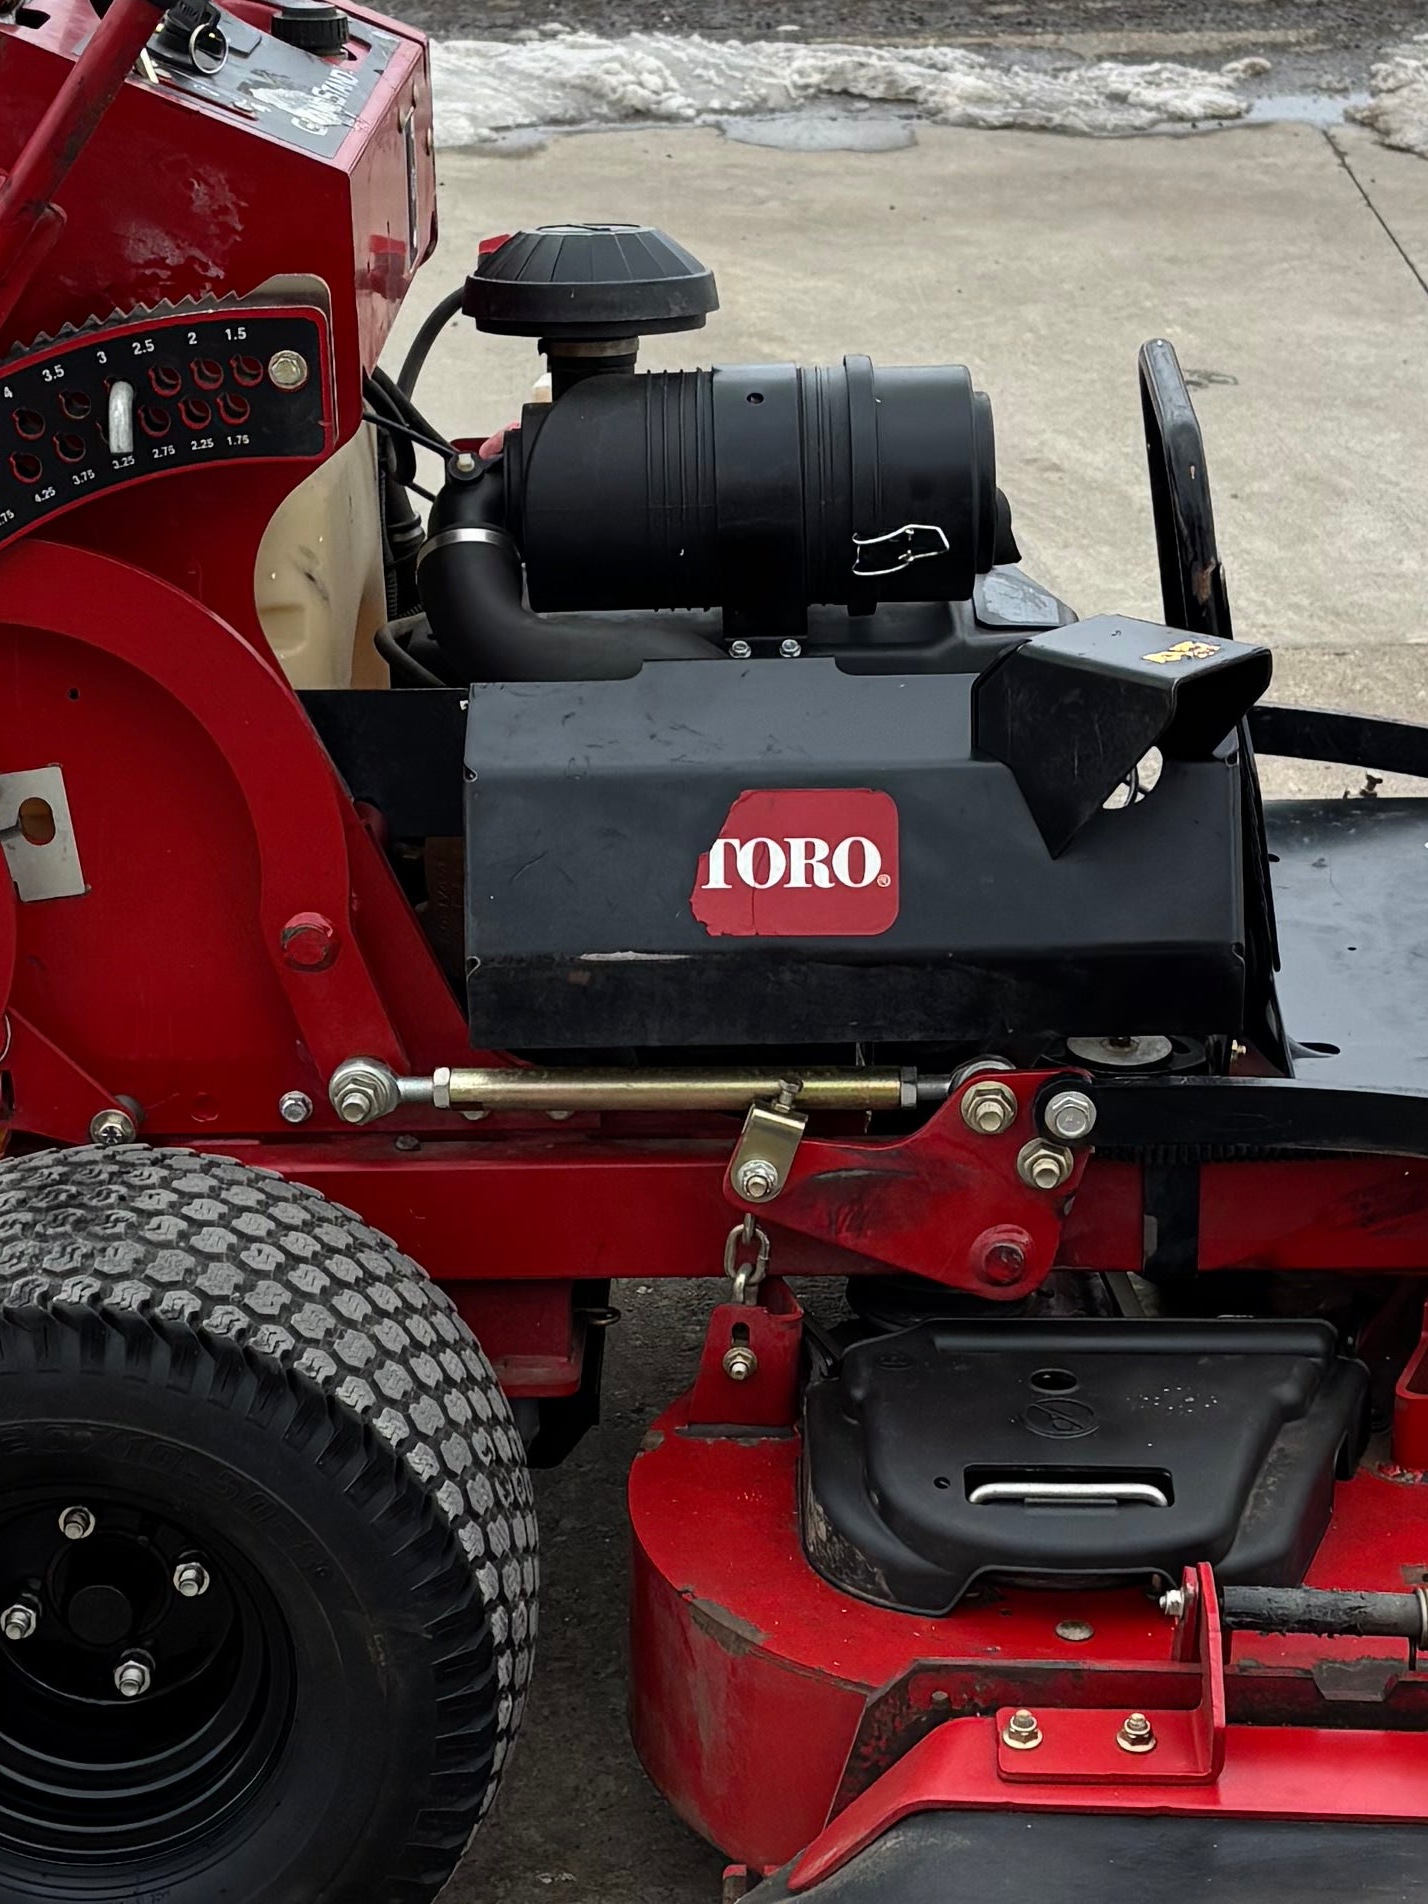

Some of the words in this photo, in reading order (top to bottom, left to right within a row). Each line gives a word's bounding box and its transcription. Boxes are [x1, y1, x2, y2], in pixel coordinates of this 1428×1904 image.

[2, 386, 13, 398] 4
[41, 364, 65, 382] 3.5
[96, 351, 108, 364] 3
[131, 338, 155, 355] 2.5
[187, 331, 198, 345] 2
[224, 326, 247, 341] 1.5
[33, 486, 56, 503] 4.25
[72, 469, 96, 485] 3.75
[112, 455, 135, 470] 3.25
[152, 444, 176, 459] 2.75
[190, 437, 215, 451] 2.25
[226, 434, 250, 446] 1.75
[701, 836, 882, 889] TORO
